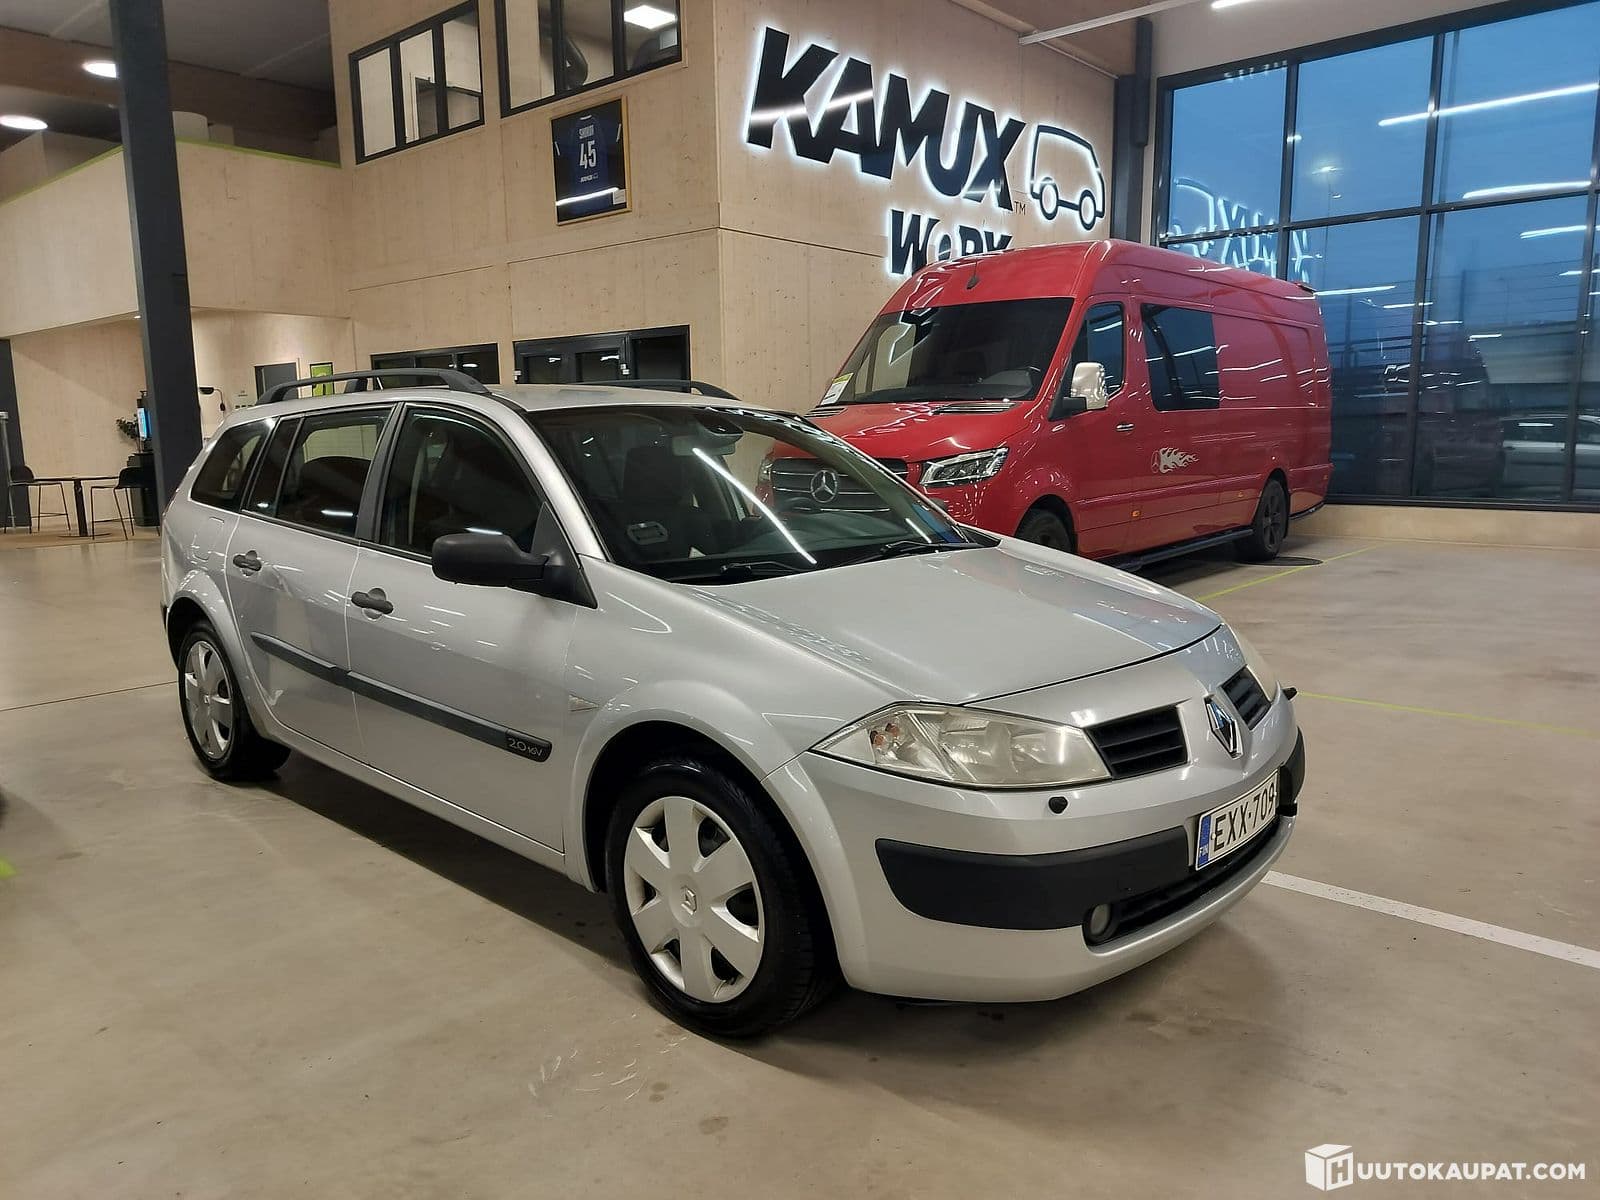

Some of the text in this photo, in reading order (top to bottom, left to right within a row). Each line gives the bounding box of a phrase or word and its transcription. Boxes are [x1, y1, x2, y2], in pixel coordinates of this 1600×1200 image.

[746, 26, 1026, 211] KAMUX
[579, 140, 597, 169] 45
[1213, 782, 1275, 852] EXX-709
